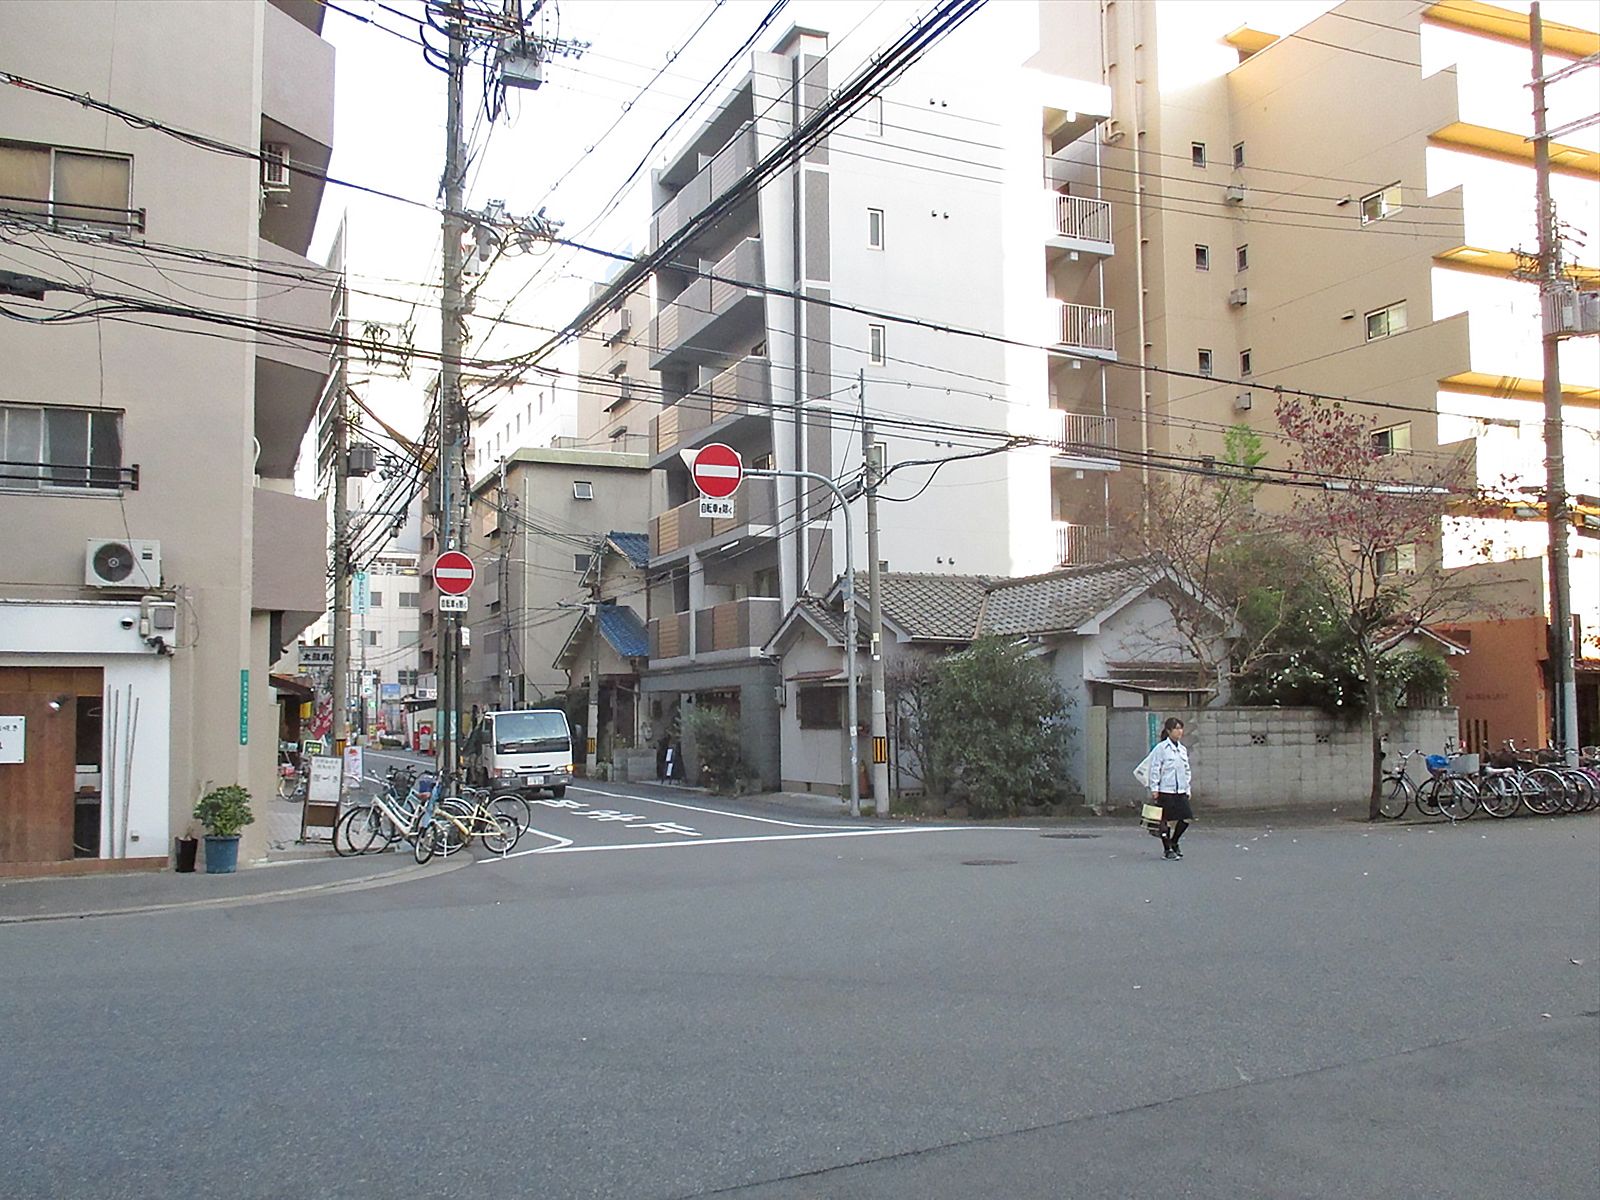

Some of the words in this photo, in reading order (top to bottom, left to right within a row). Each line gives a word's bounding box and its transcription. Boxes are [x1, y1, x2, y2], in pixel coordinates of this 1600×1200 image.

[701, 503, 732, 514] 自転車を除く
